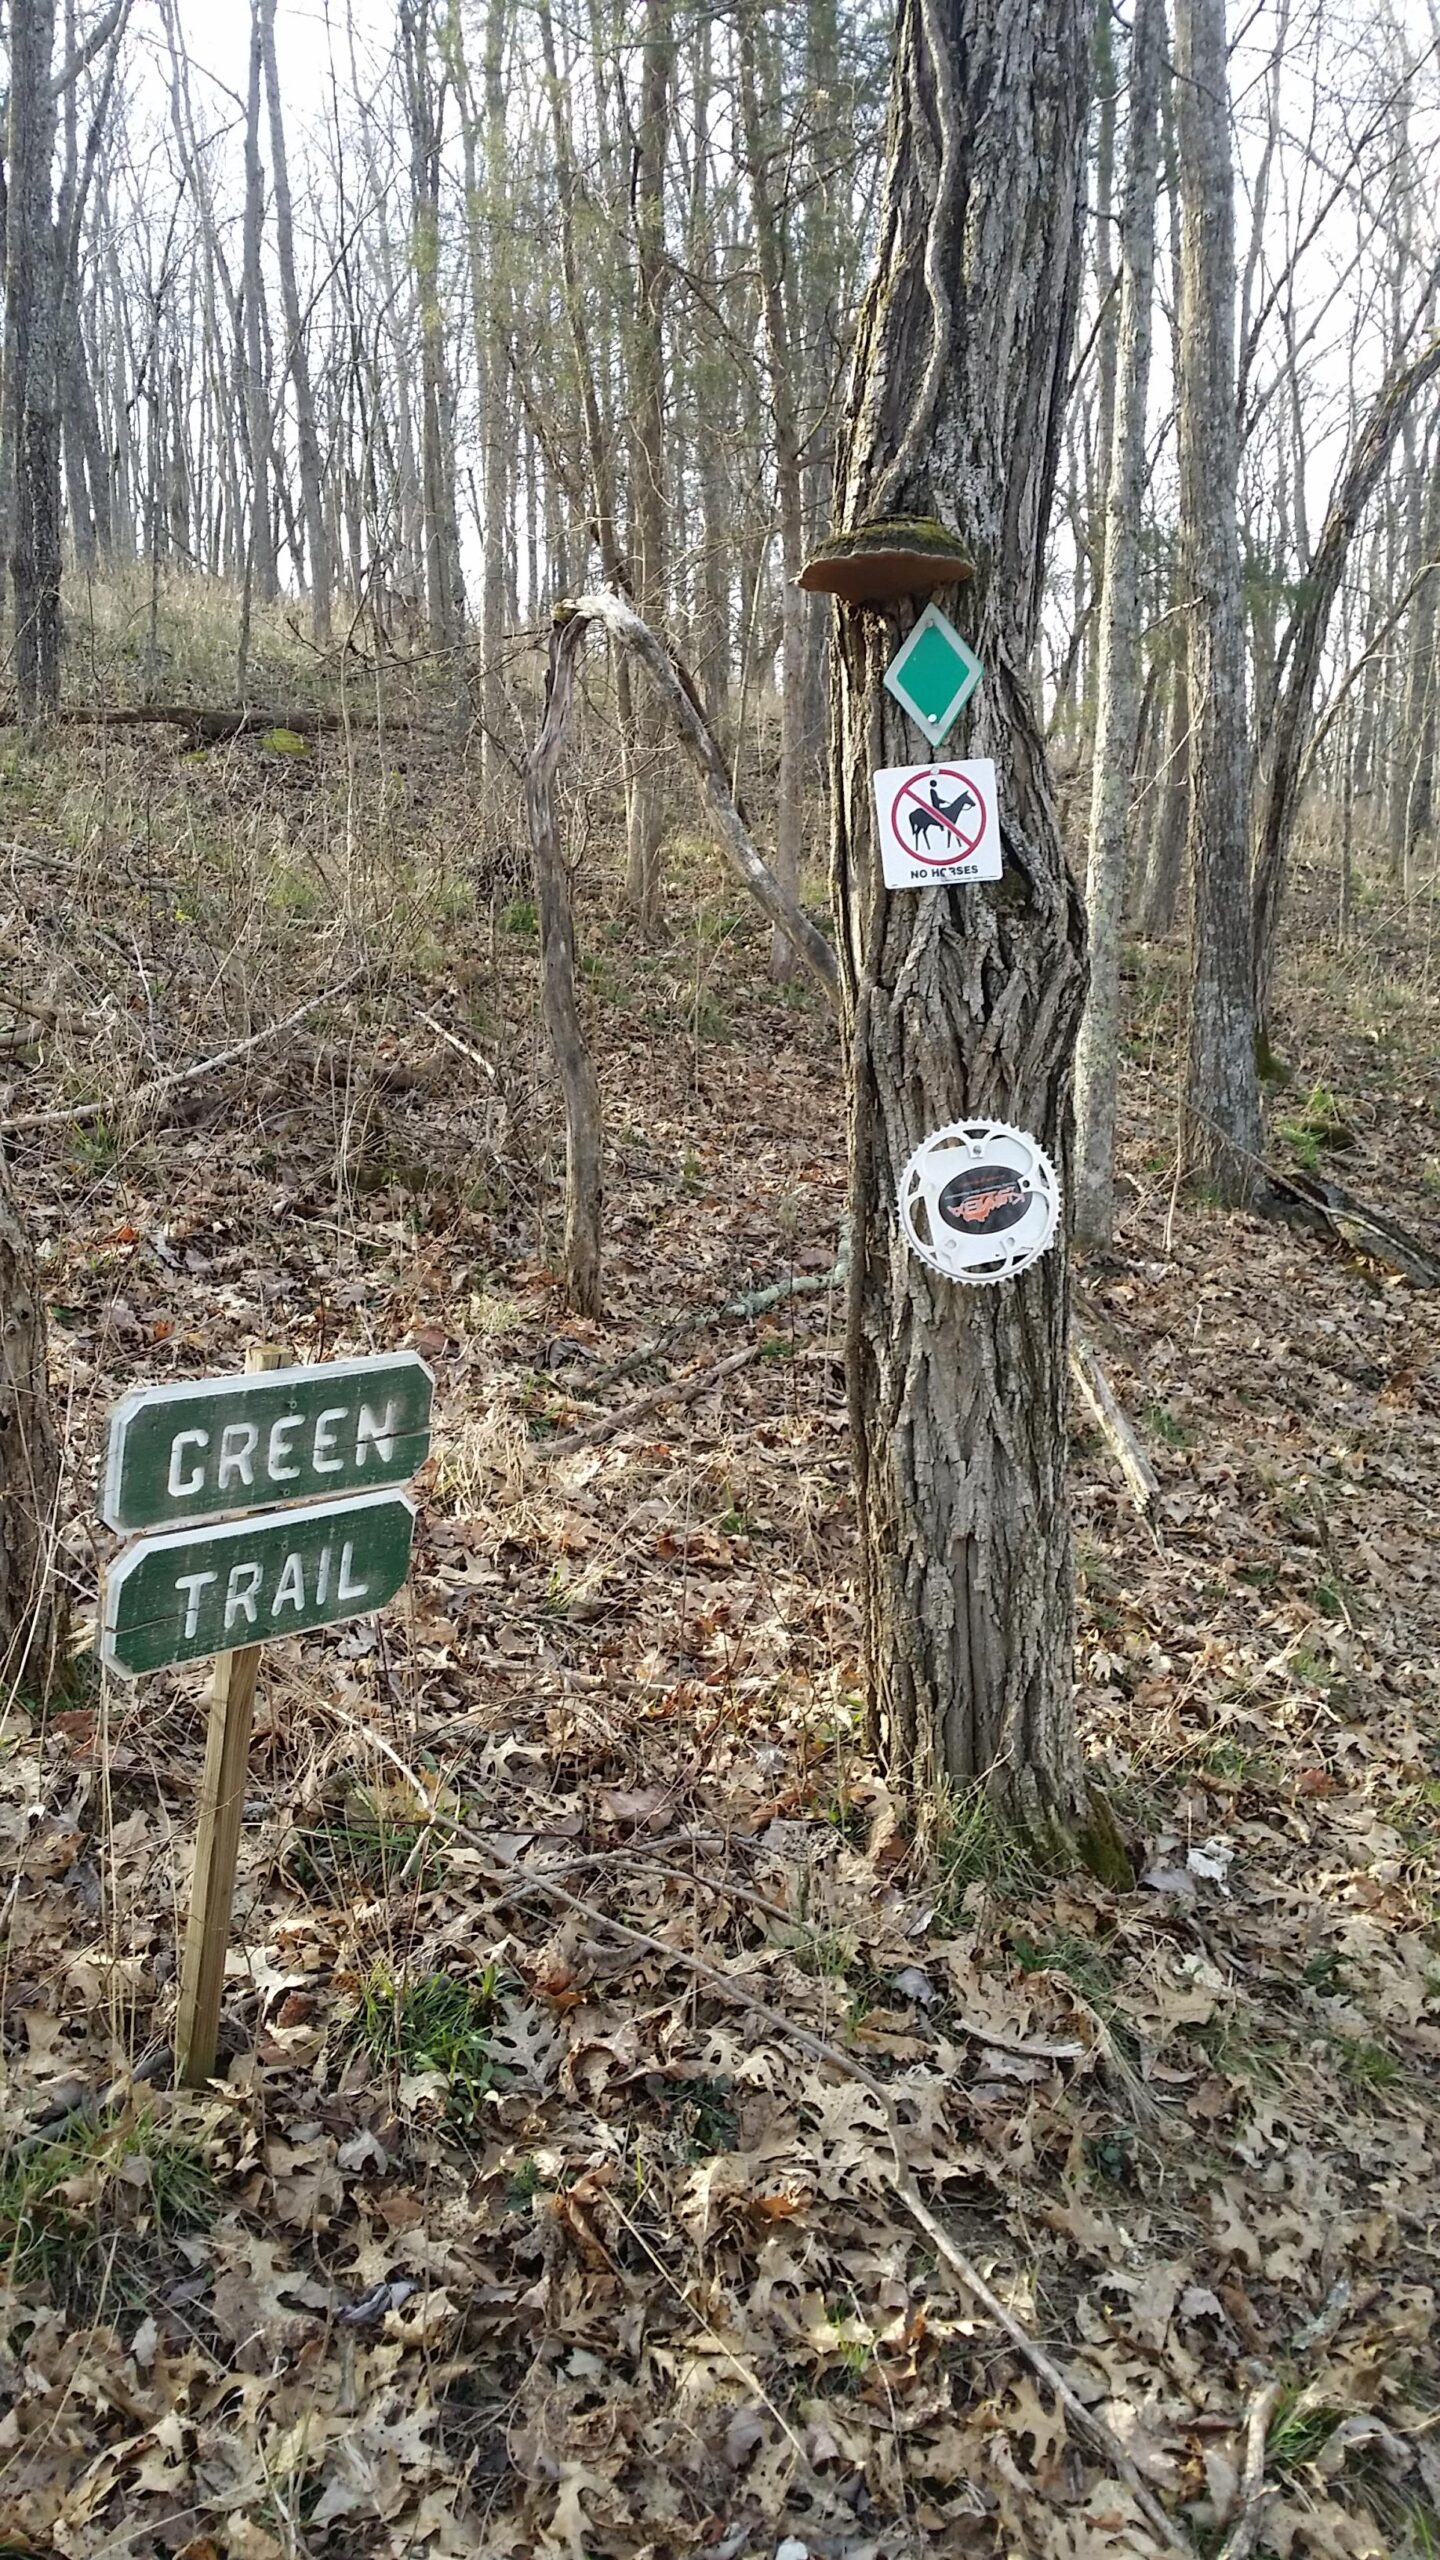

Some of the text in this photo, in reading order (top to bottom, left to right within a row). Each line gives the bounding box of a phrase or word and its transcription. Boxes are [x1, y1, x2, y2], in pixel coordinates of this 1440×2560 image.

[910, 869, 928, 879] NO
[167, 1399, 395, 1497] GREEN
[174, 1541, 369, 1639] TRAIL
